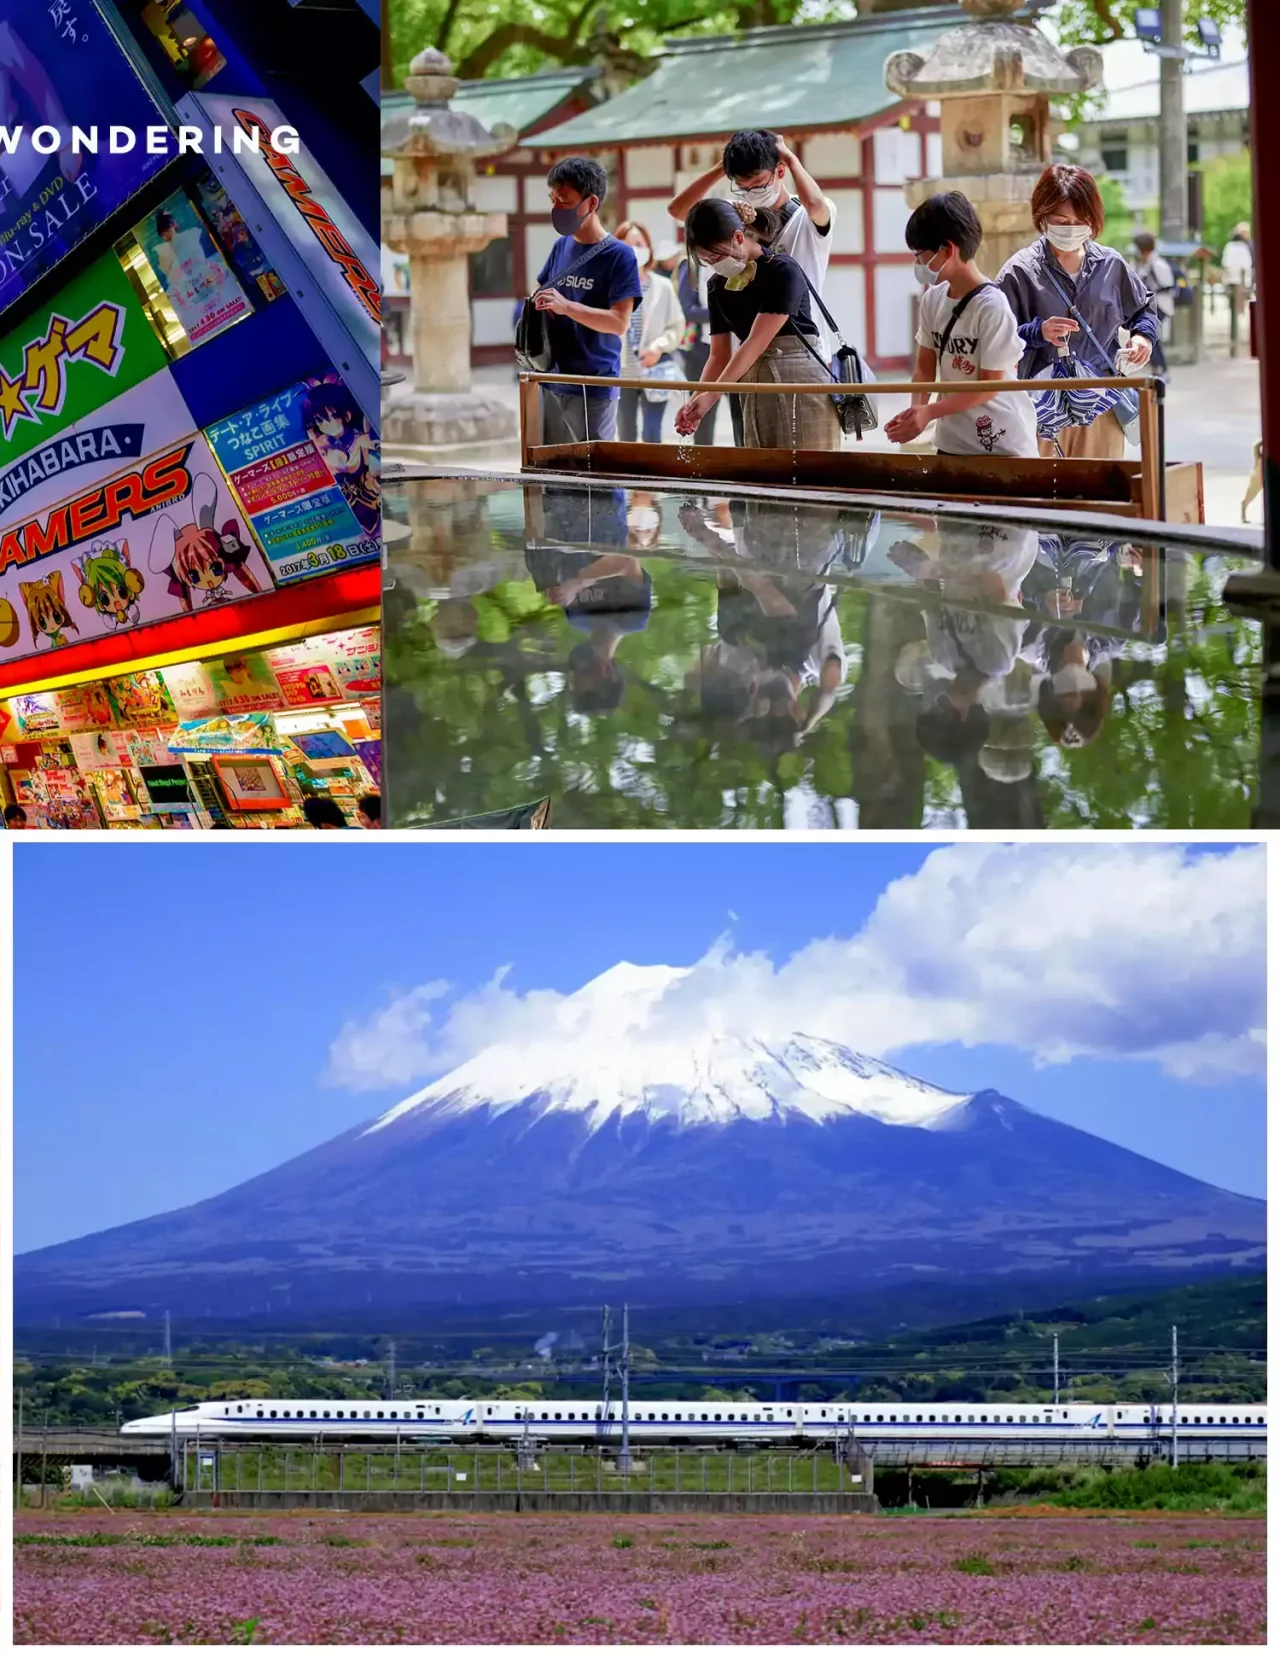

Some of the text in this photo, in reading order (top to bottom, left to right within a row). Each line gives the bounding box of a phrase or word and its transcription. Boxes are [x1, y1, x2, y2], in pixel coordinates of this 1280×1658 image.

[38, 175, 66, 206] DVD
[29, 172, 99, 244] SALE
[244, 434, 286, 461] SPIRIT
